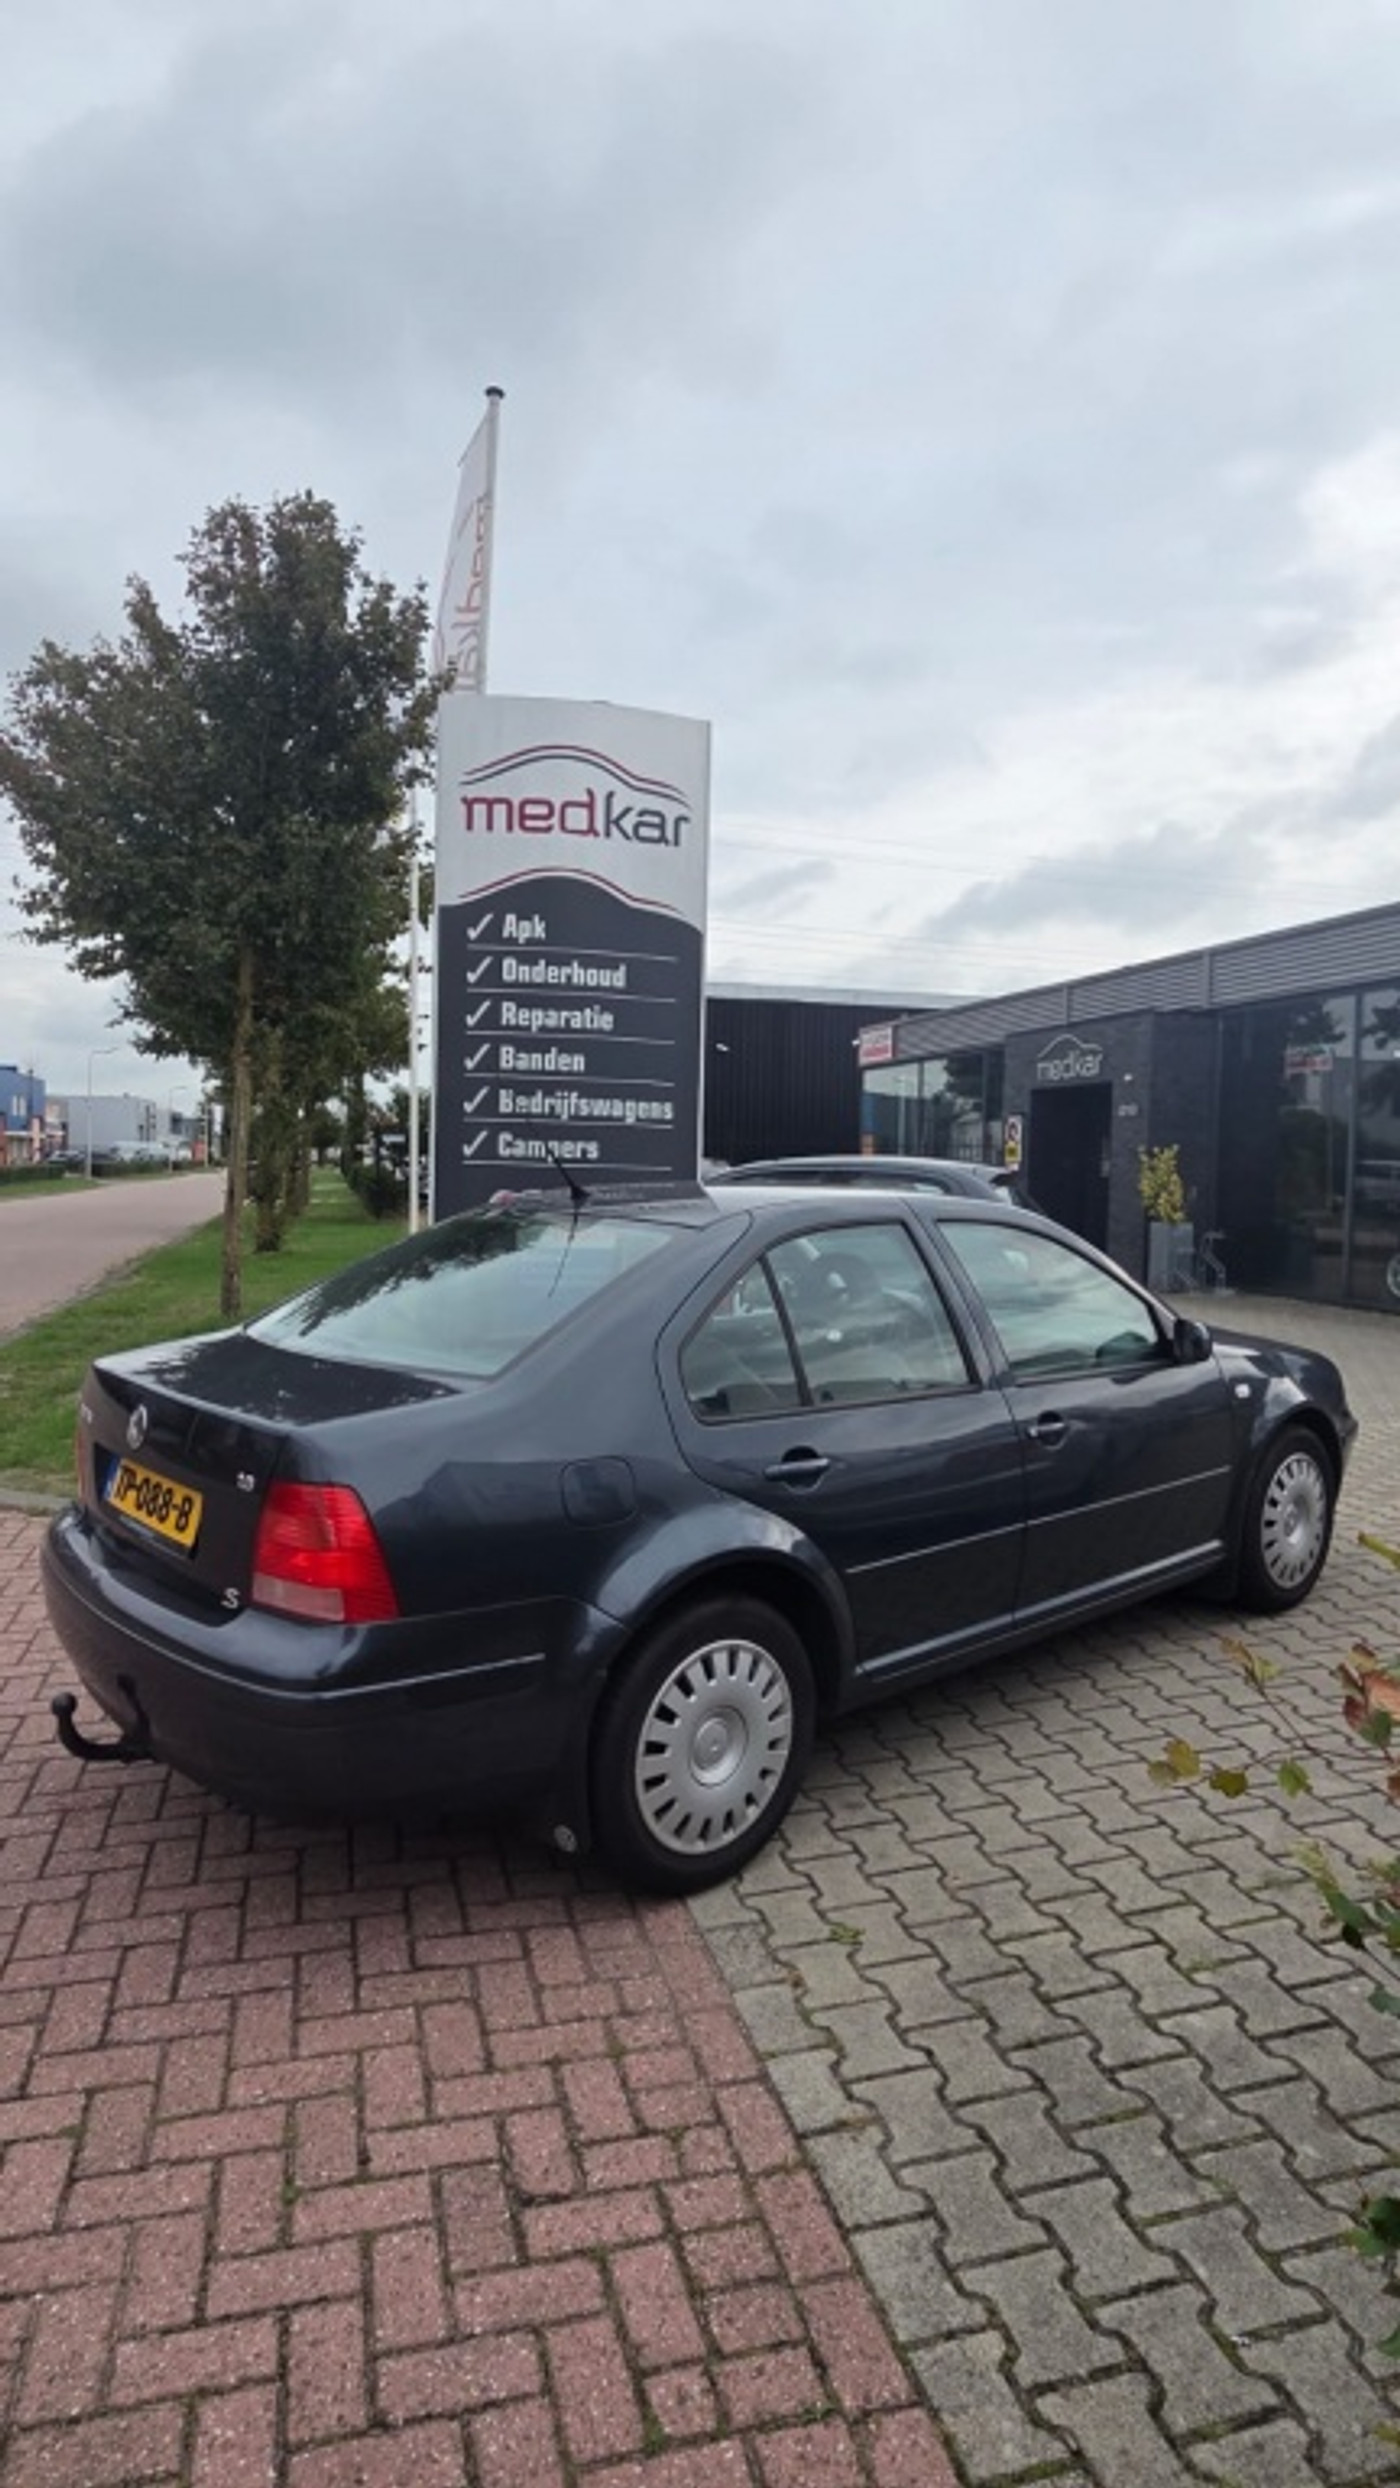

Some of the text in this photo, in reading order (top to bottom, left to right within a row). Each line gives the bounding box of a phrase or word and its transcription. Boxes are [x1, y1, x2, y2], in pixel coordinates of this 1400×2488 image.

[460, 787, 690, 847] medkar
[502, 913, 546, 944] Apk
[501, 957, 626, 988] Onderhoud
[501, 1001, 614, 1032] Reparatie
[500, 1045, 585, 1072] Banden
[499, 1089, 674, 1124] Bedrijfswagens
[221, 1587, 240, 1609] S
